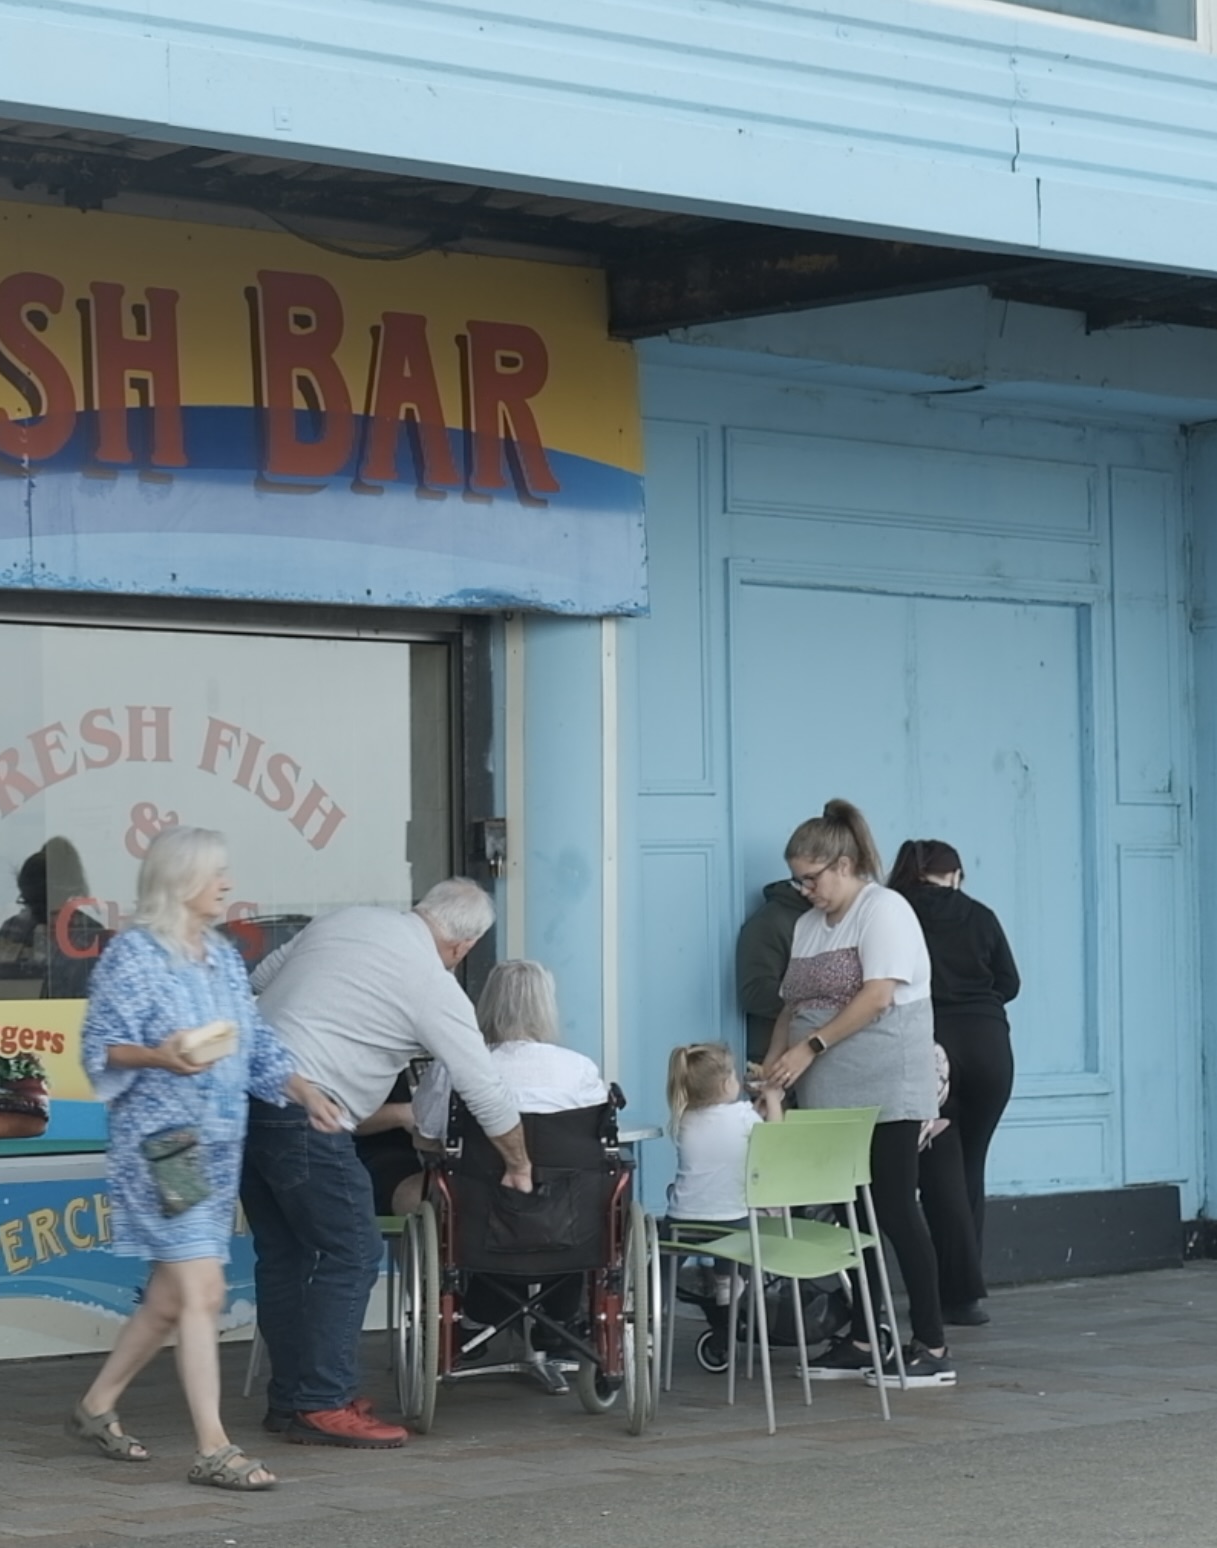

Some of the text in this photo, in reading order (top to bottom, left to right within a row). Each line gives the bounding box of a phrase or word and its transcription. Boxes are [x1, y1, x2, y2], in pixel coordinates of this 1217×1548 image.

[244, 269, 561, 508] BAR
[124, 801, 181, 860] &
[196, 714, 348, 851] FISH
